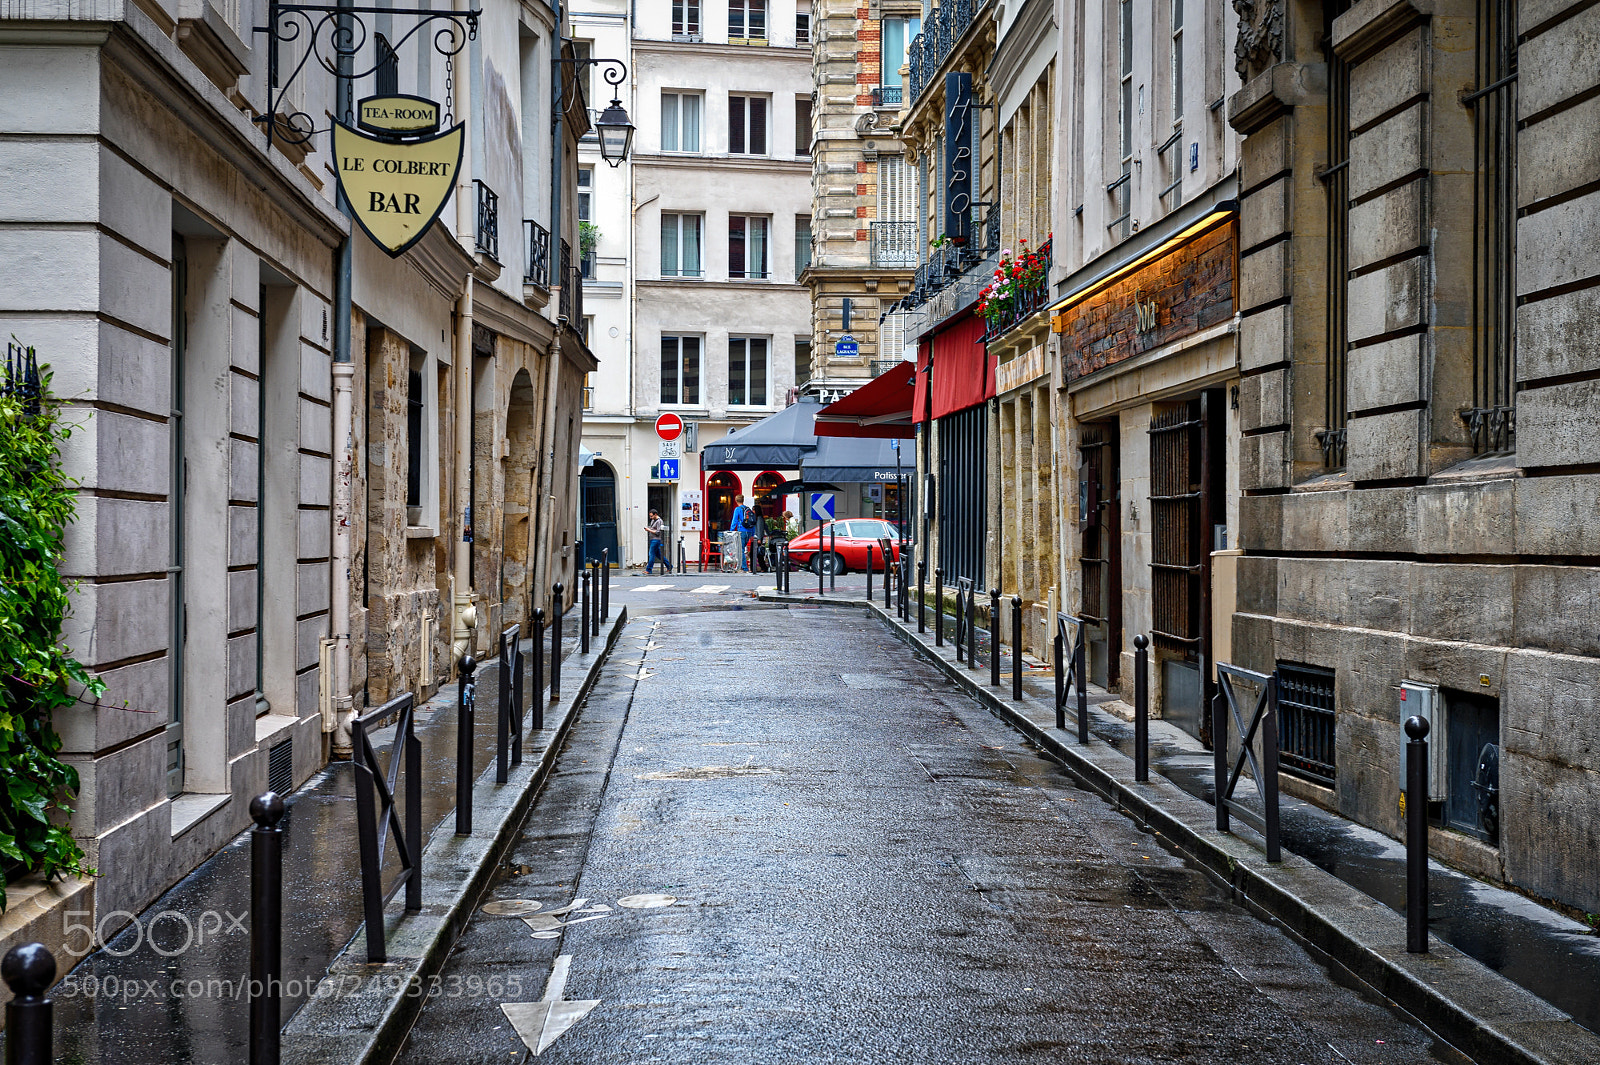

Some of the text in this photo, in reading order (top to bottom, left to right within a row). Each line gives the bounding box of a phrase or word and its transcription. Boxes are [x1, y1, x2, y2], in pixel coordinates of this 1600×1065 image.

[364, 107, 433, 120] TEA-ROOM
[949, 75, 971, 236] HIPPO
[343, 157, 450, 176] LE COLBERT
[368, 191, 421, 214] BAR
[1135, 288, 1156, 335] Sola
[874, 472, 907, 480] Patisser
